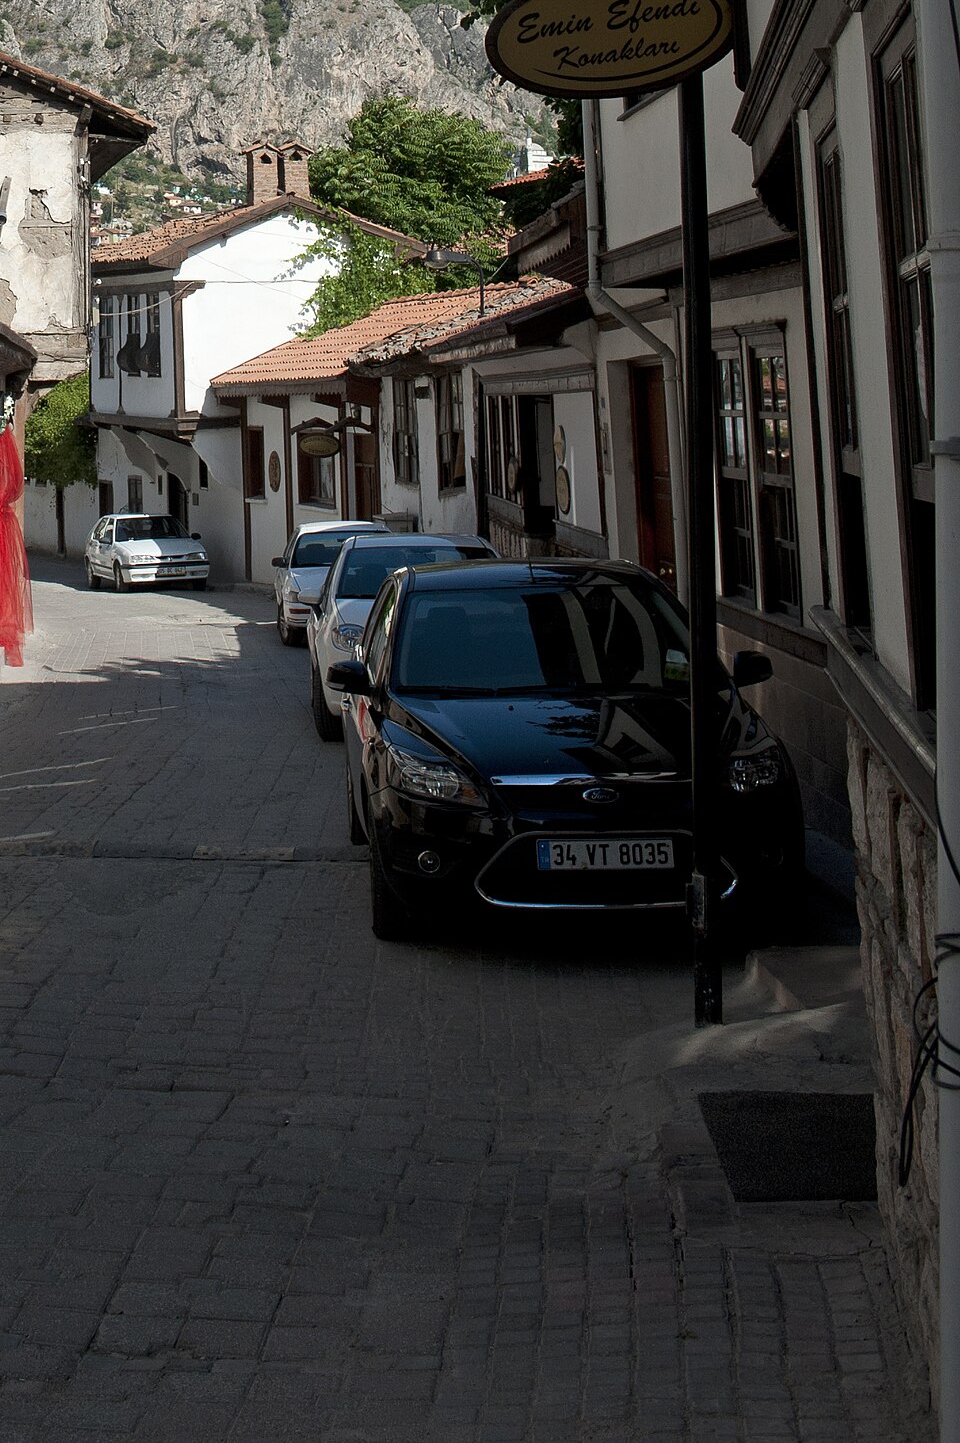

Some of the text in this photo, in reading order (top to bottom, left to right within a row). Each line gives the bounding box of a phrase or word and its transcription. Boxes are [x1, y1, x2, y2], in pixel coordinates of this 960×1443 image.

[517, 12, 594, 44] Emin
[552, 38, 680, 70] Konakları
[552, 843, 669, 866] 34 VT 8035
